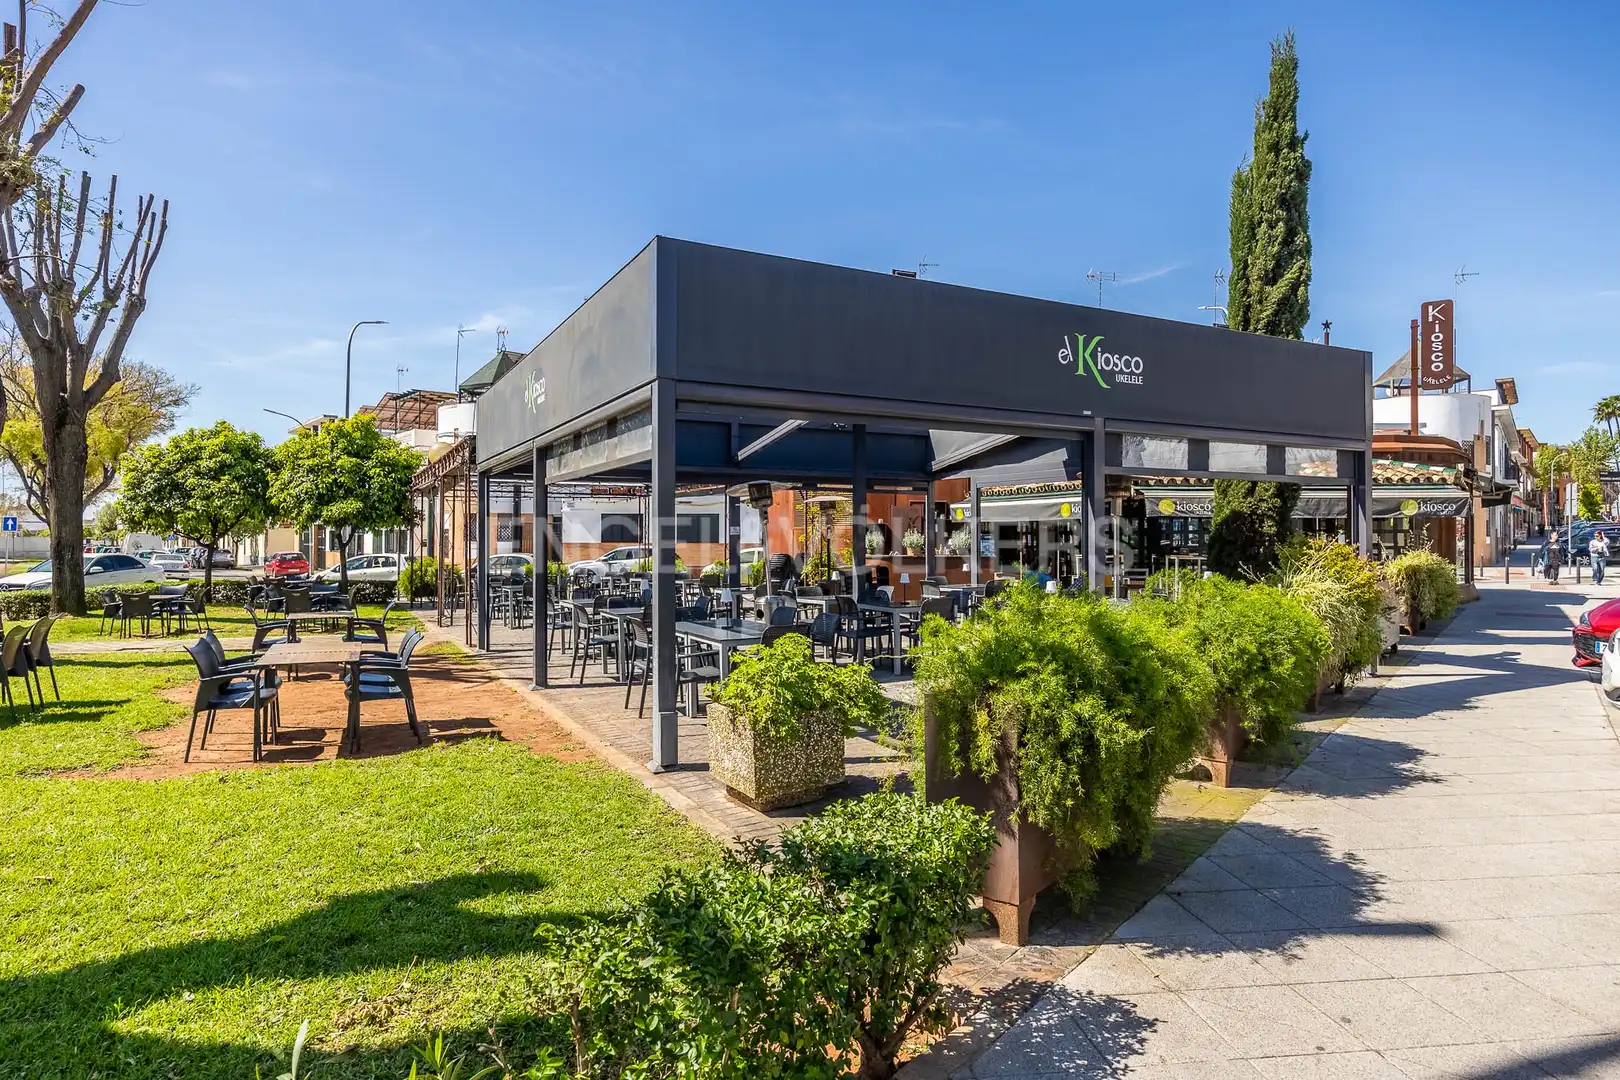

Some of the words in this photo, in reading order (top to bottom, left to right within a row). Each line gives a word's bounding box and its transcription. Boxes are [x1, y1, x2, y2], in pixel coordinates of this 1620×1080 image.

[1428, 303, 1446, 372] Kiosco
[1058, 335, 1074, 364] el
[1074, 332, 1144, 389] Kiosco
[1115, 373, 1144, 385] UKELELE
[1176, 500, 1212, 511] kiosco
[1420, 500, 1456, 512] kiosco
